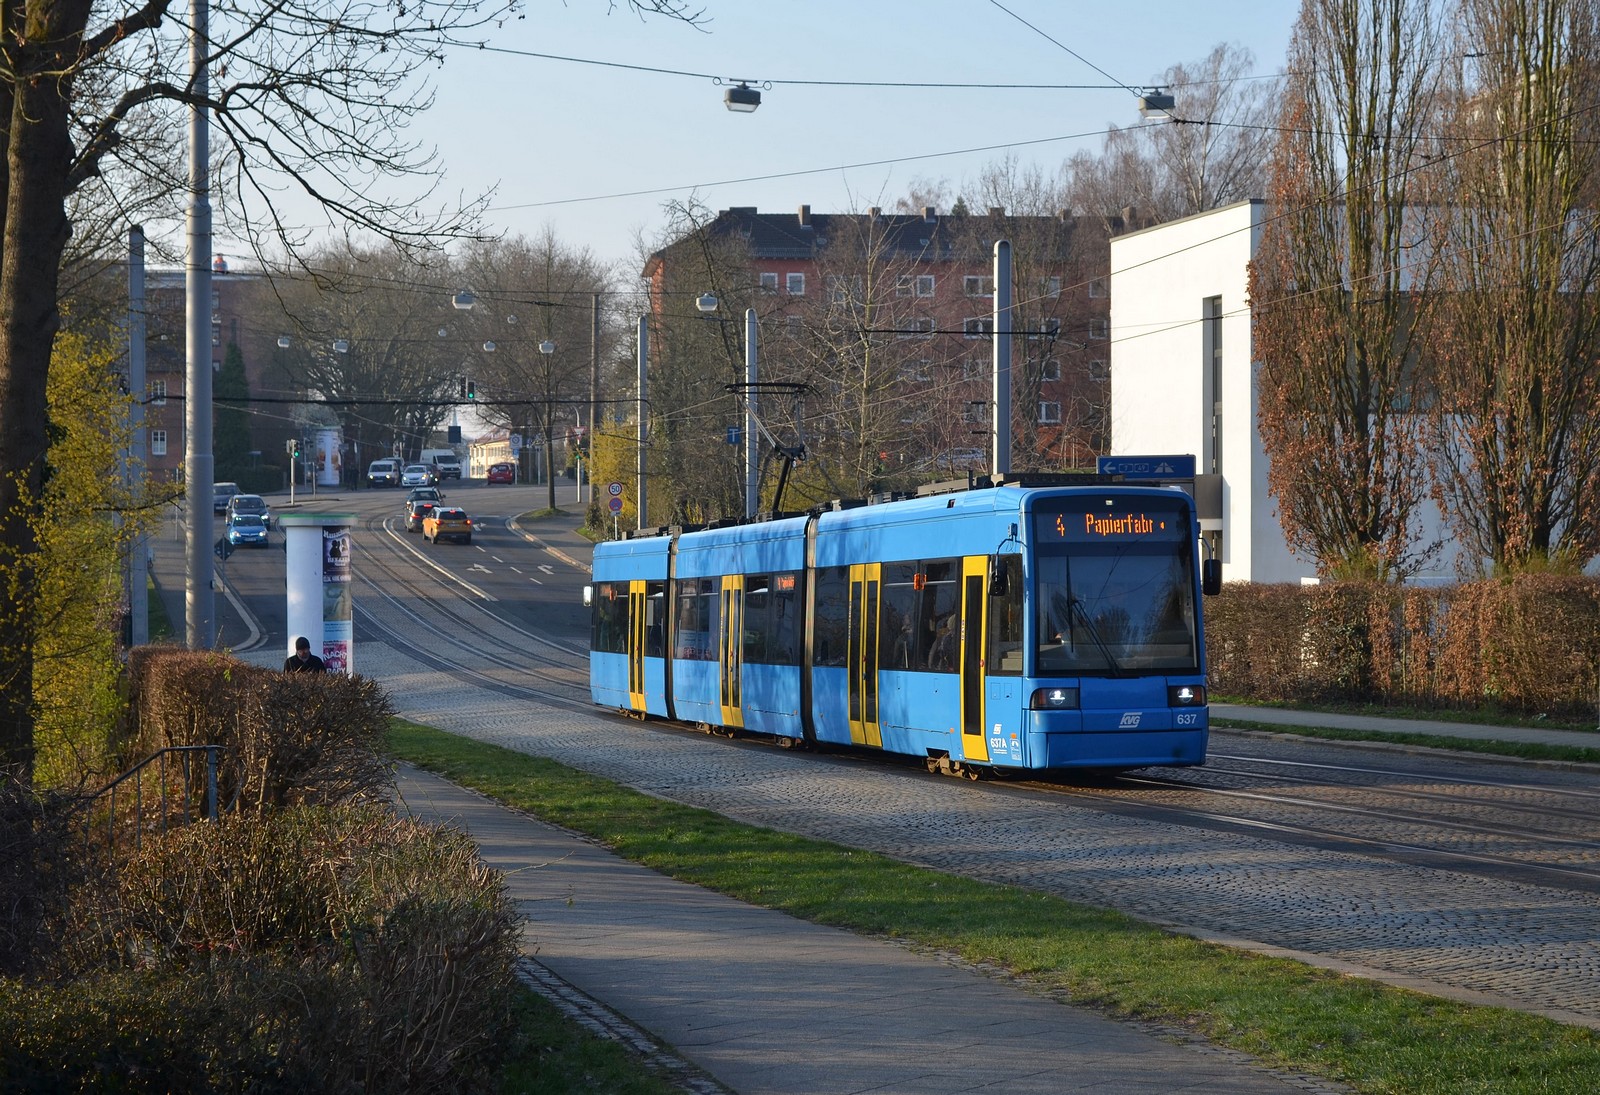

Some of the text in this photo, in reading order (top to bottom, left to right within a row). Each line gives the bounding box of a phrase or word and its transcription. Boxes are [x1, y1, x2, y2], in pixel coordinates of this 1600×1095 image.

[611, 485, 620, 493] 50
[1120, 714, 1141, 727] KVG
[1177, 714, 1197, 725] 637
[990, 737, 1008, 749] 637A
